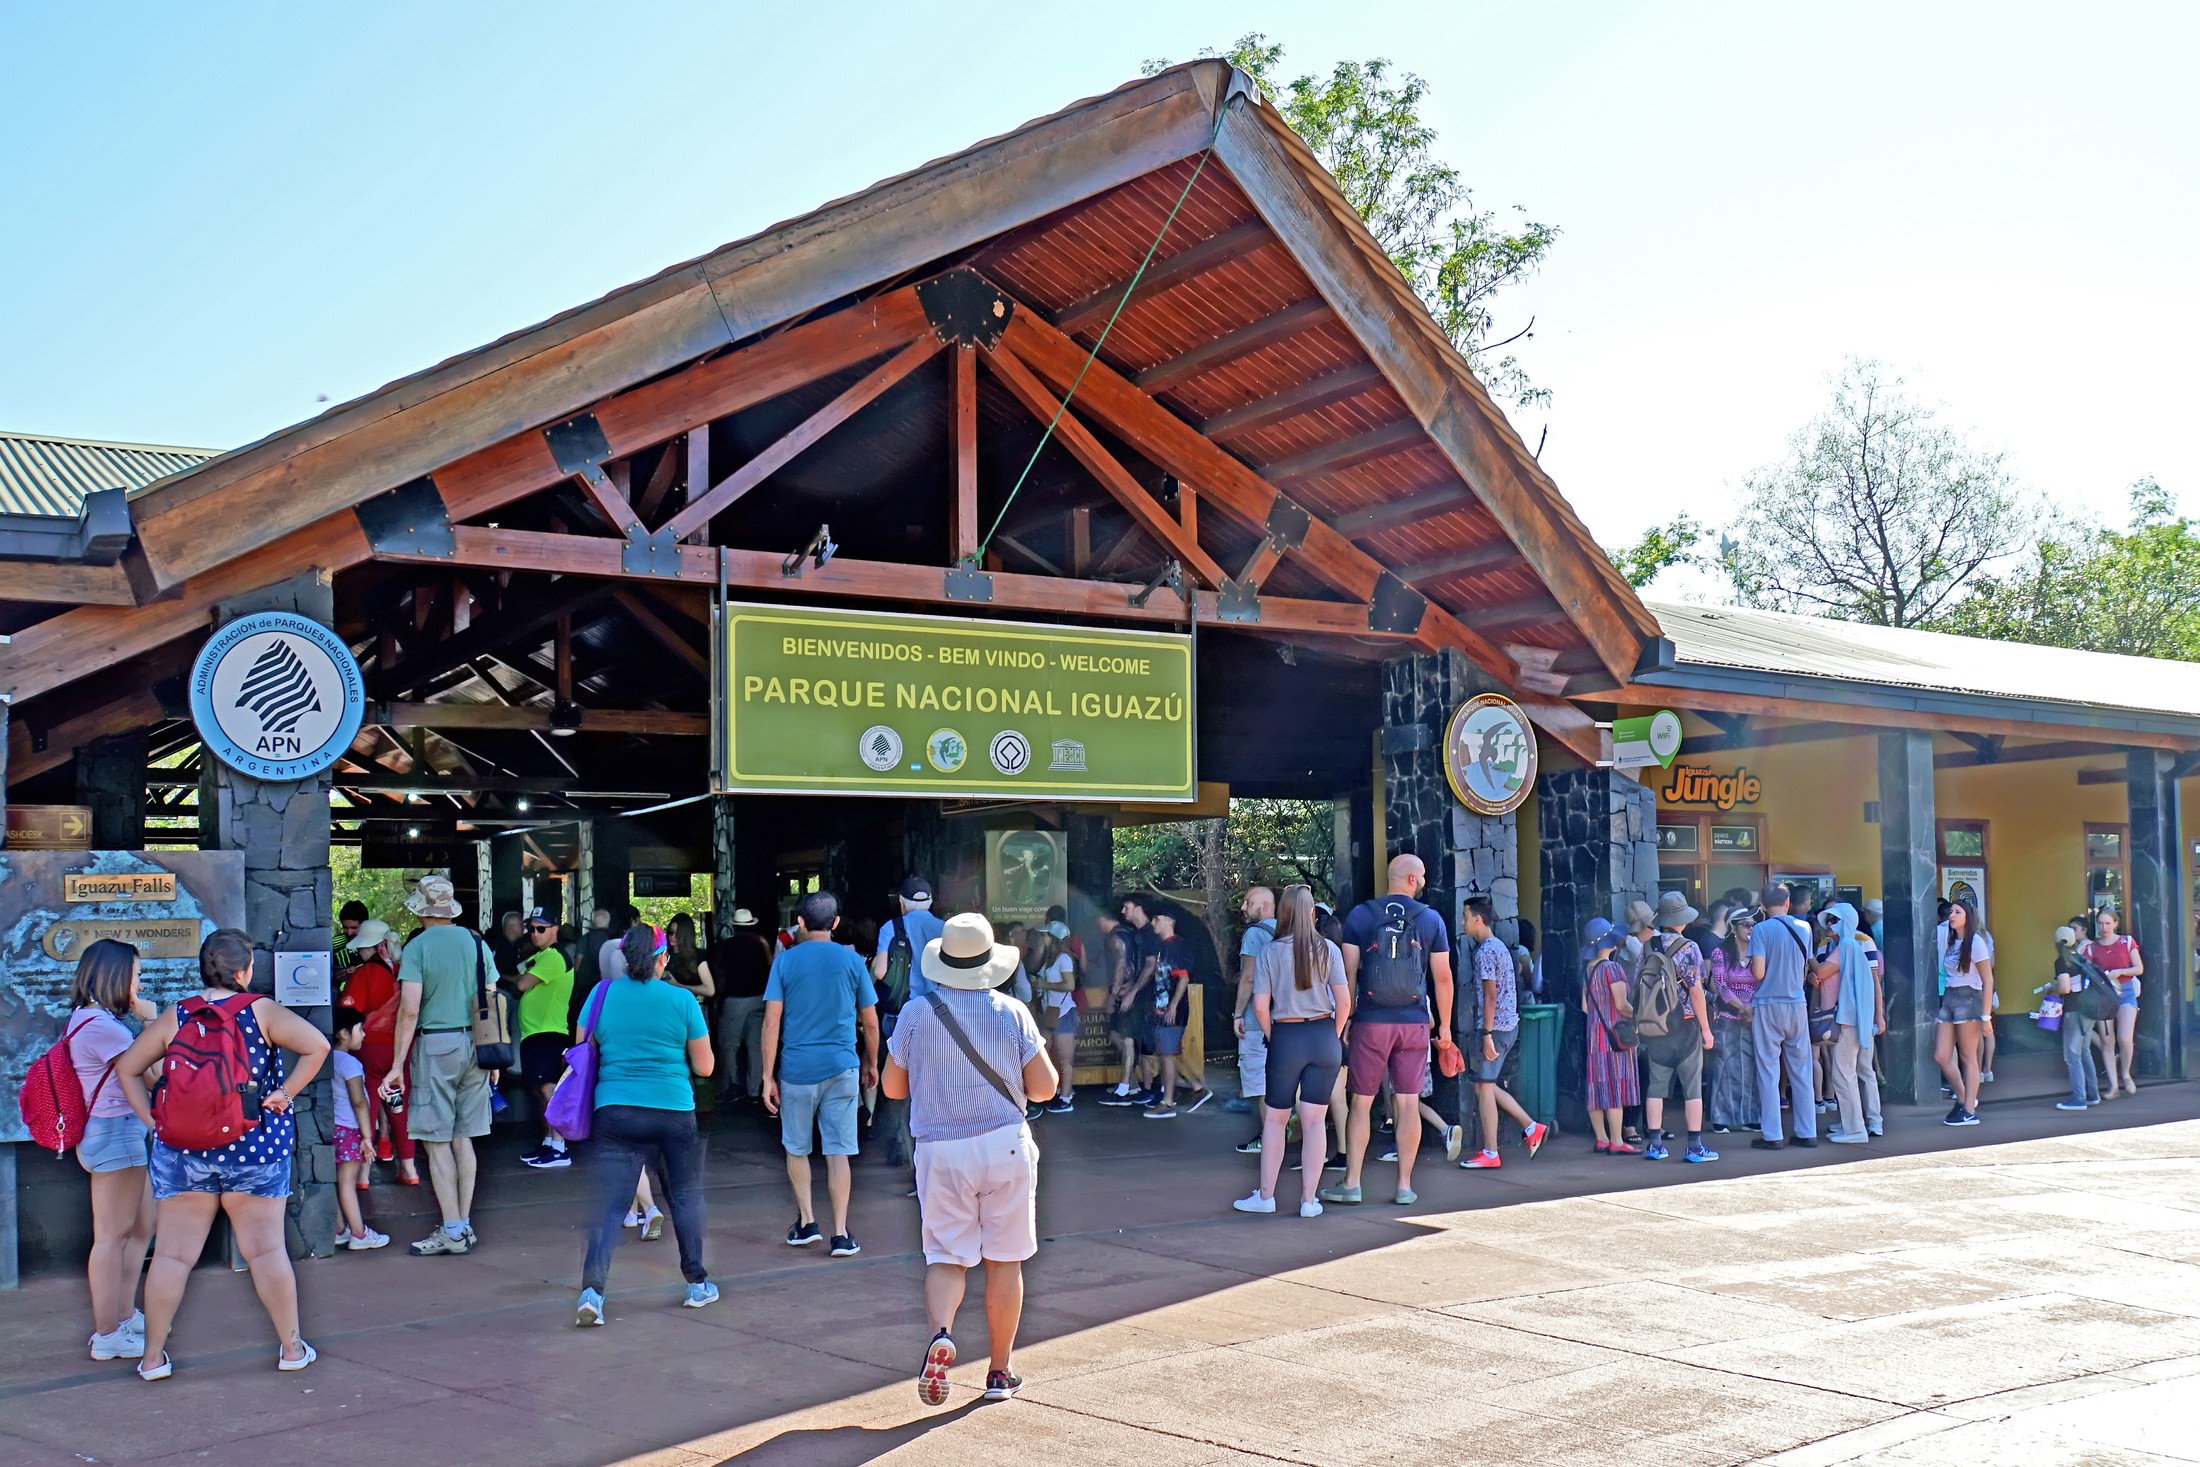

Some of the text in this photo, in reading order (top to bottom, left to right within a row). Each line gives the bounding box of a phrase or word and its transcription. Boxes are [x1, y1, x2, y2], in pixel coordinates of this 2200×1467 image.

[197, 618, 359, 703] ADMINISTRACIÓN de PARQUES NACIONALES
[783, 637, 923, 662] BIENVENIDOS
[939, 647, 980, 665] BEM
[985, 650, 1045, 669] VINDO
[1060, 654, 1150, 675] WELCOME
[744, 675, 1182, 721] PARQUE NACIONAL IGUAZÚ
[1462, 701, 1480, 720] PARQUE
[1480, 698, 1506, 708] NACIONAL
[255, 736, 301, 753] APN
[223, 747, 332, 775] ARGENTINA
[1052, 747, 1085, 764] UNESCO
[1664, 767, 1761, 810] Jungle
[6, 830, 44, 839] ASHDESK
[1947, 869, 1978, 877] Bienvenidos
[71, 878, 171, 897] Iguazu Falls
[1018, 906, 1033, 914] viaje
[95, 928, 191, 939] NEW 7 WONDERS
[1085, 1026, 1107, 1036] DEL
